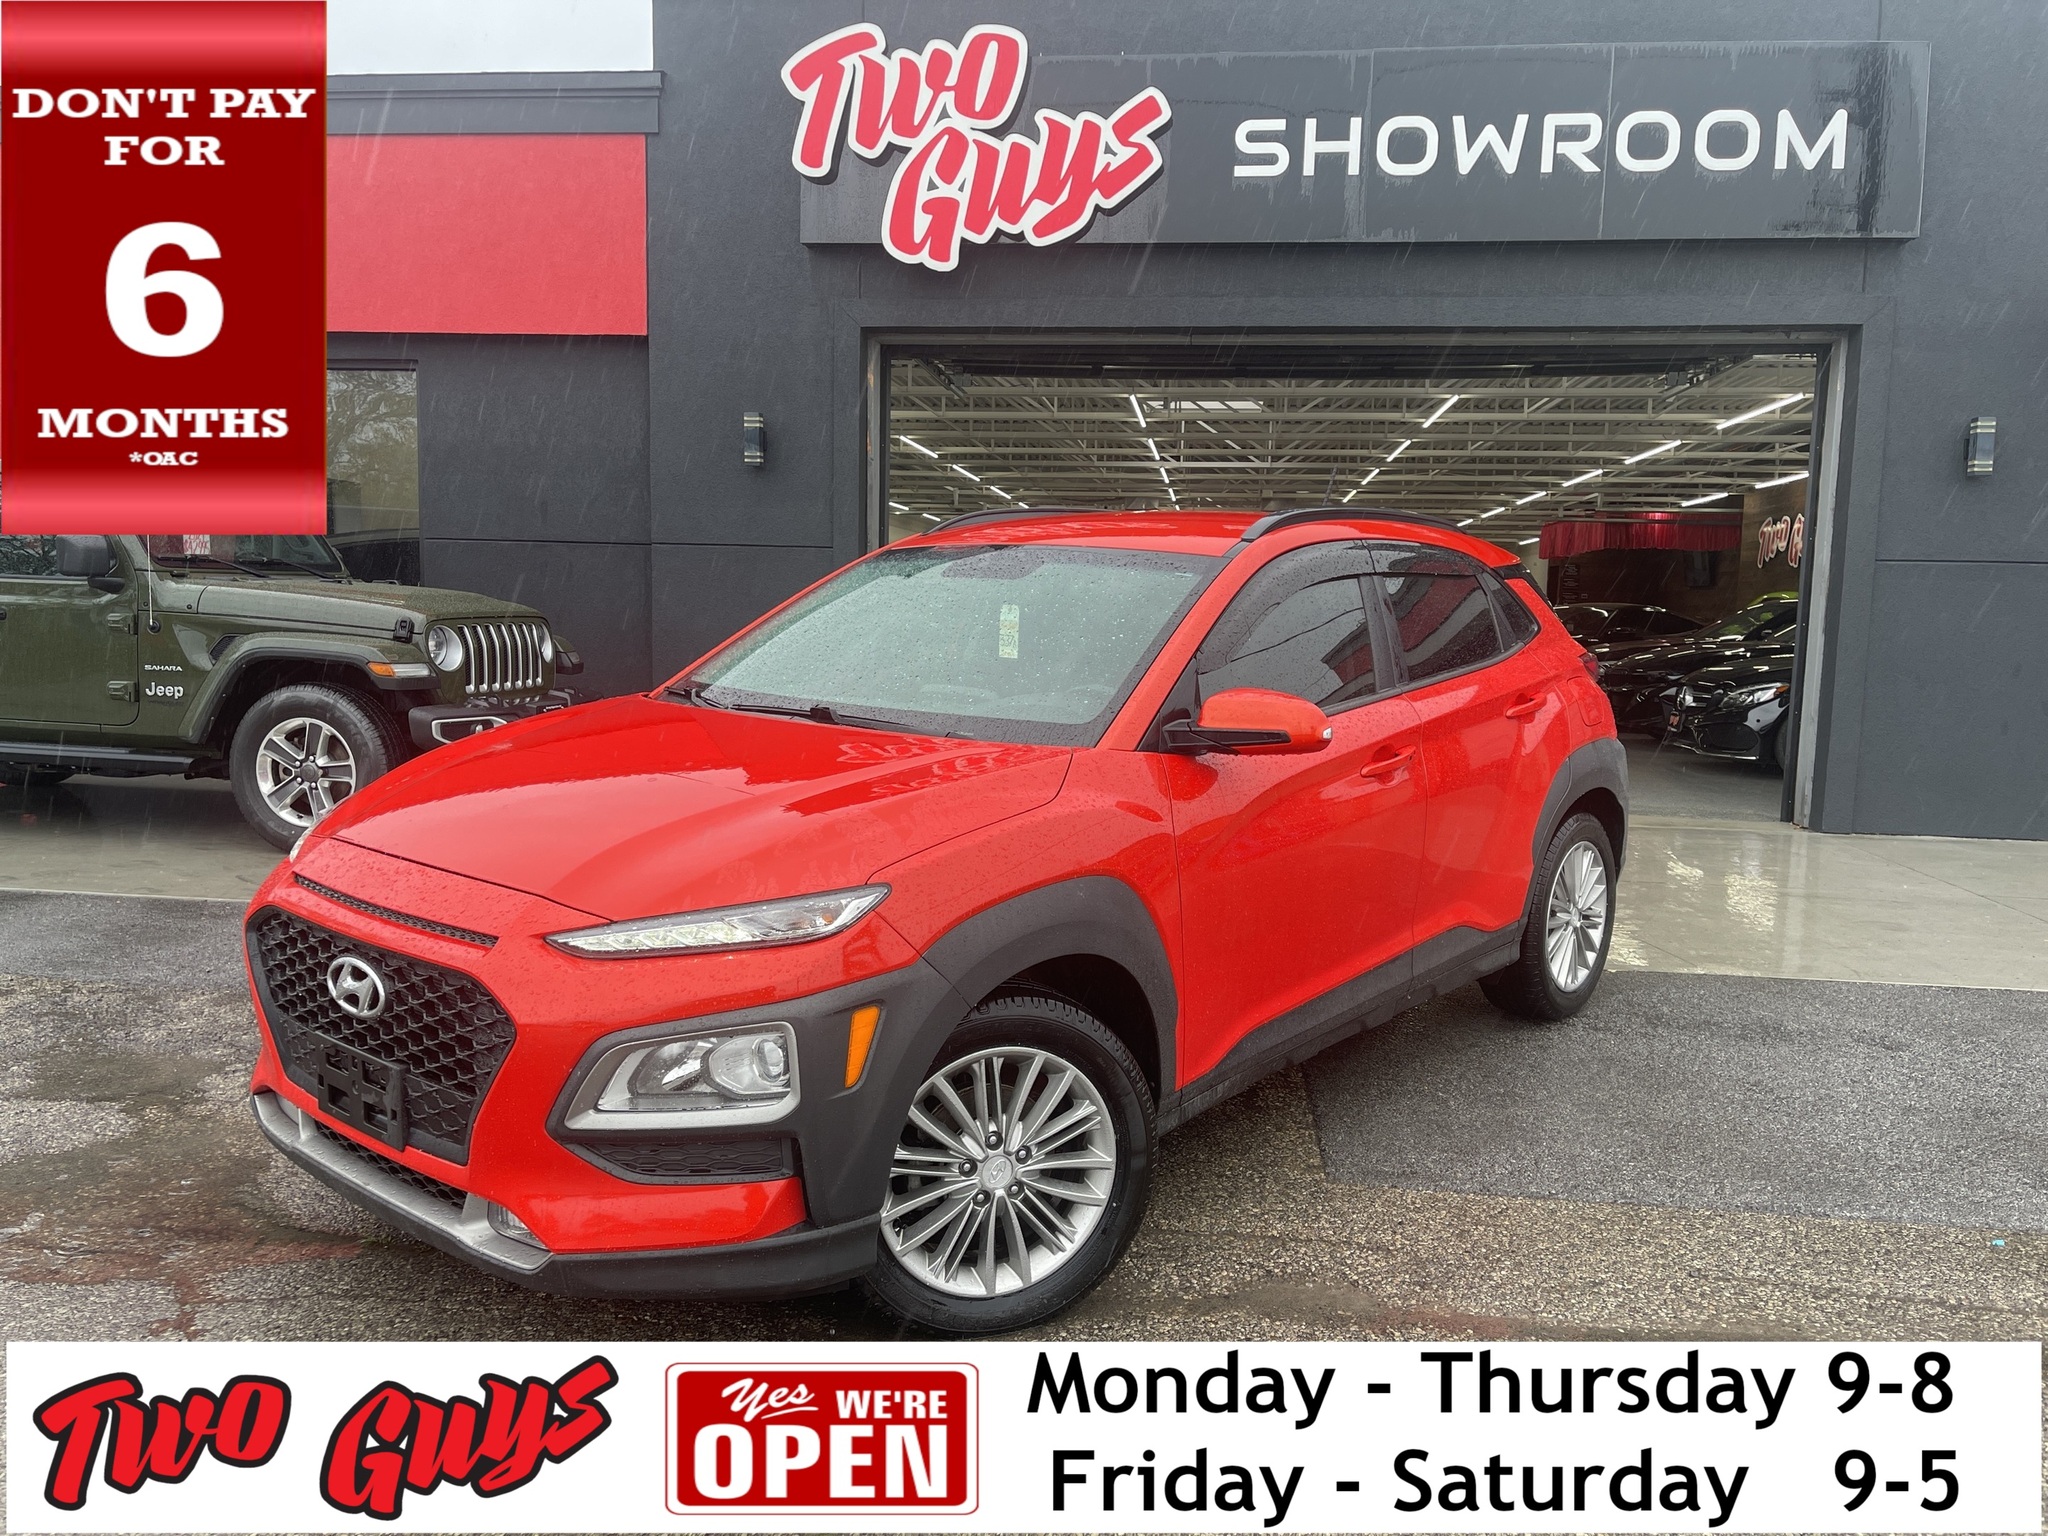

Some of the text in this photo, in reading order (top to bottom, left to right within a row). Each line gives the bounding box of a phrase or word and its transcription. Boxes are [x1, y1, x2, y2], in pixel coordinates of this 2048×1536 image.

[782, 23, 1027, 176] Two
[1233, 108, 1848, 177] SHOWROOM
[883, 88, 1171, 271] Guys
[145, 681, 184, 700] Jeep
